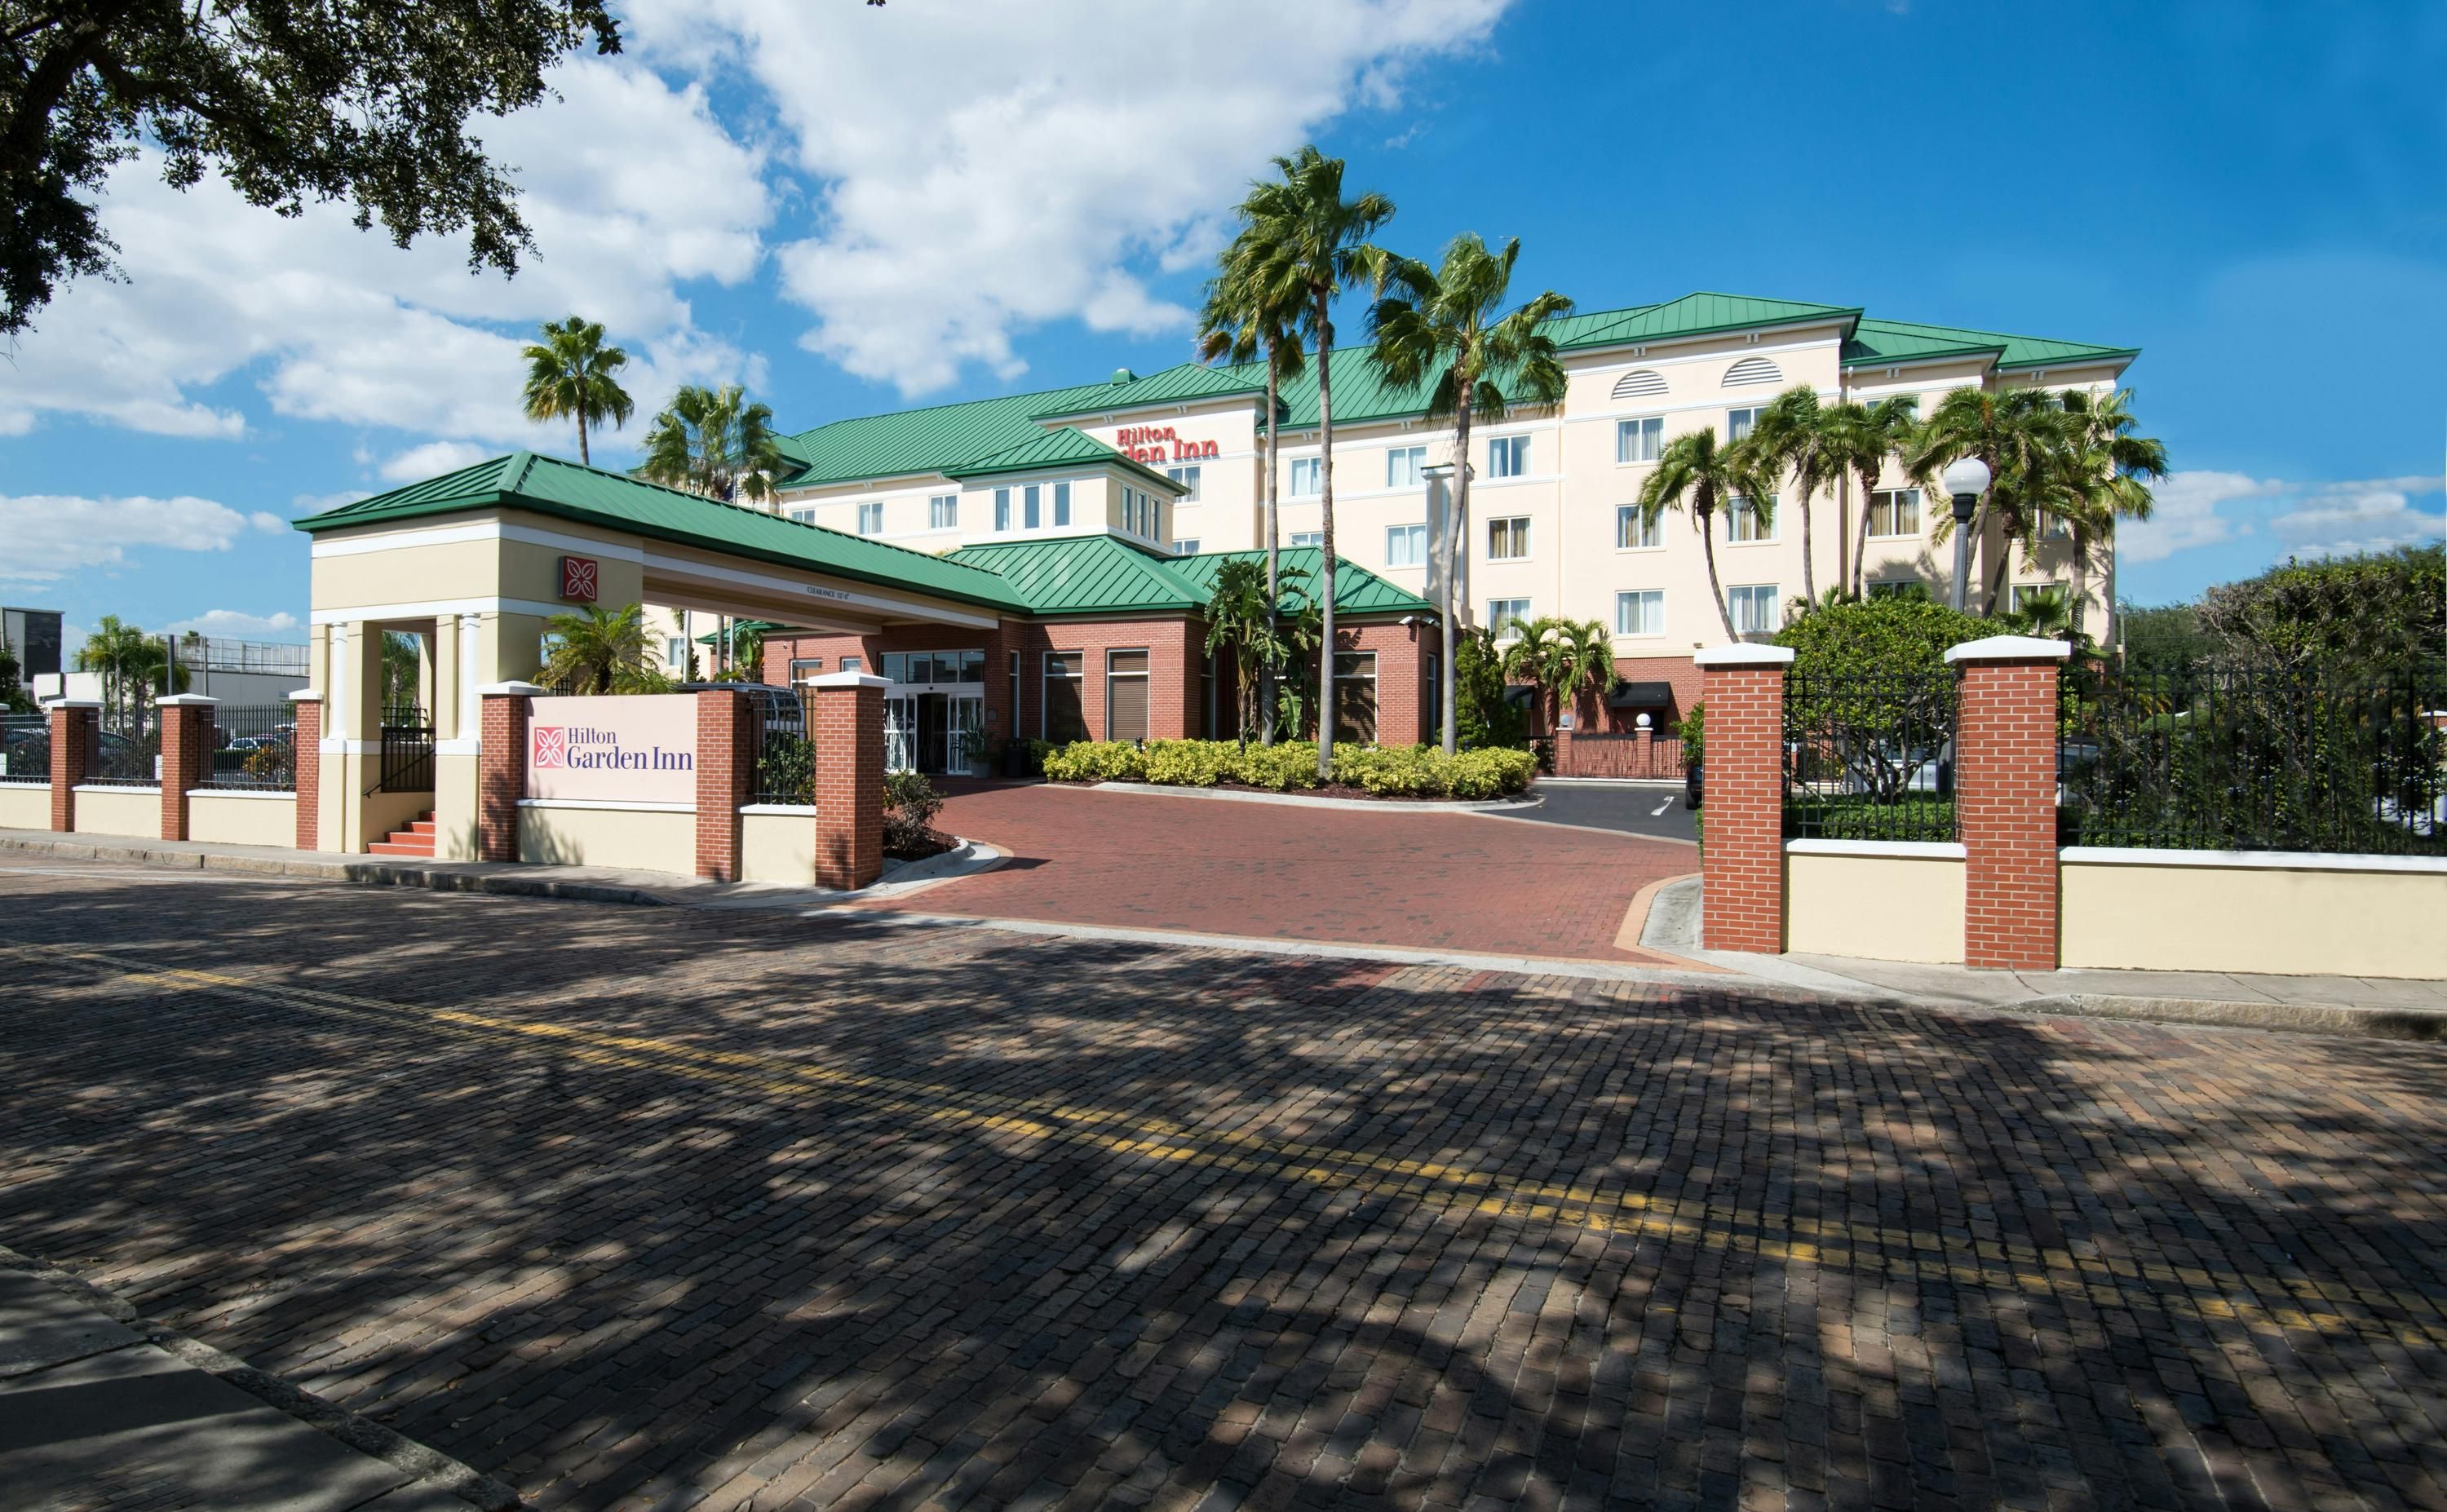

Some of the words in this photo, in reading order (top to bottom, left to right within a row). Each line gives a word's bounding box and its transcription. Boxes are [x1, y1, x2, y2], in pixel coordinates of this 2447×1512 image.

[1117, 426, 1176, 445] Hilton
[1122, 443, 1167, 463] den
[1173, 439, 1219, 458] Inn
[808, 586, 834, 597] CLEARANCE
[568, 727, 617, 745] Hilton
[567, 745, 649, 770] Garden
[652, 746, 693, 771] Inn
